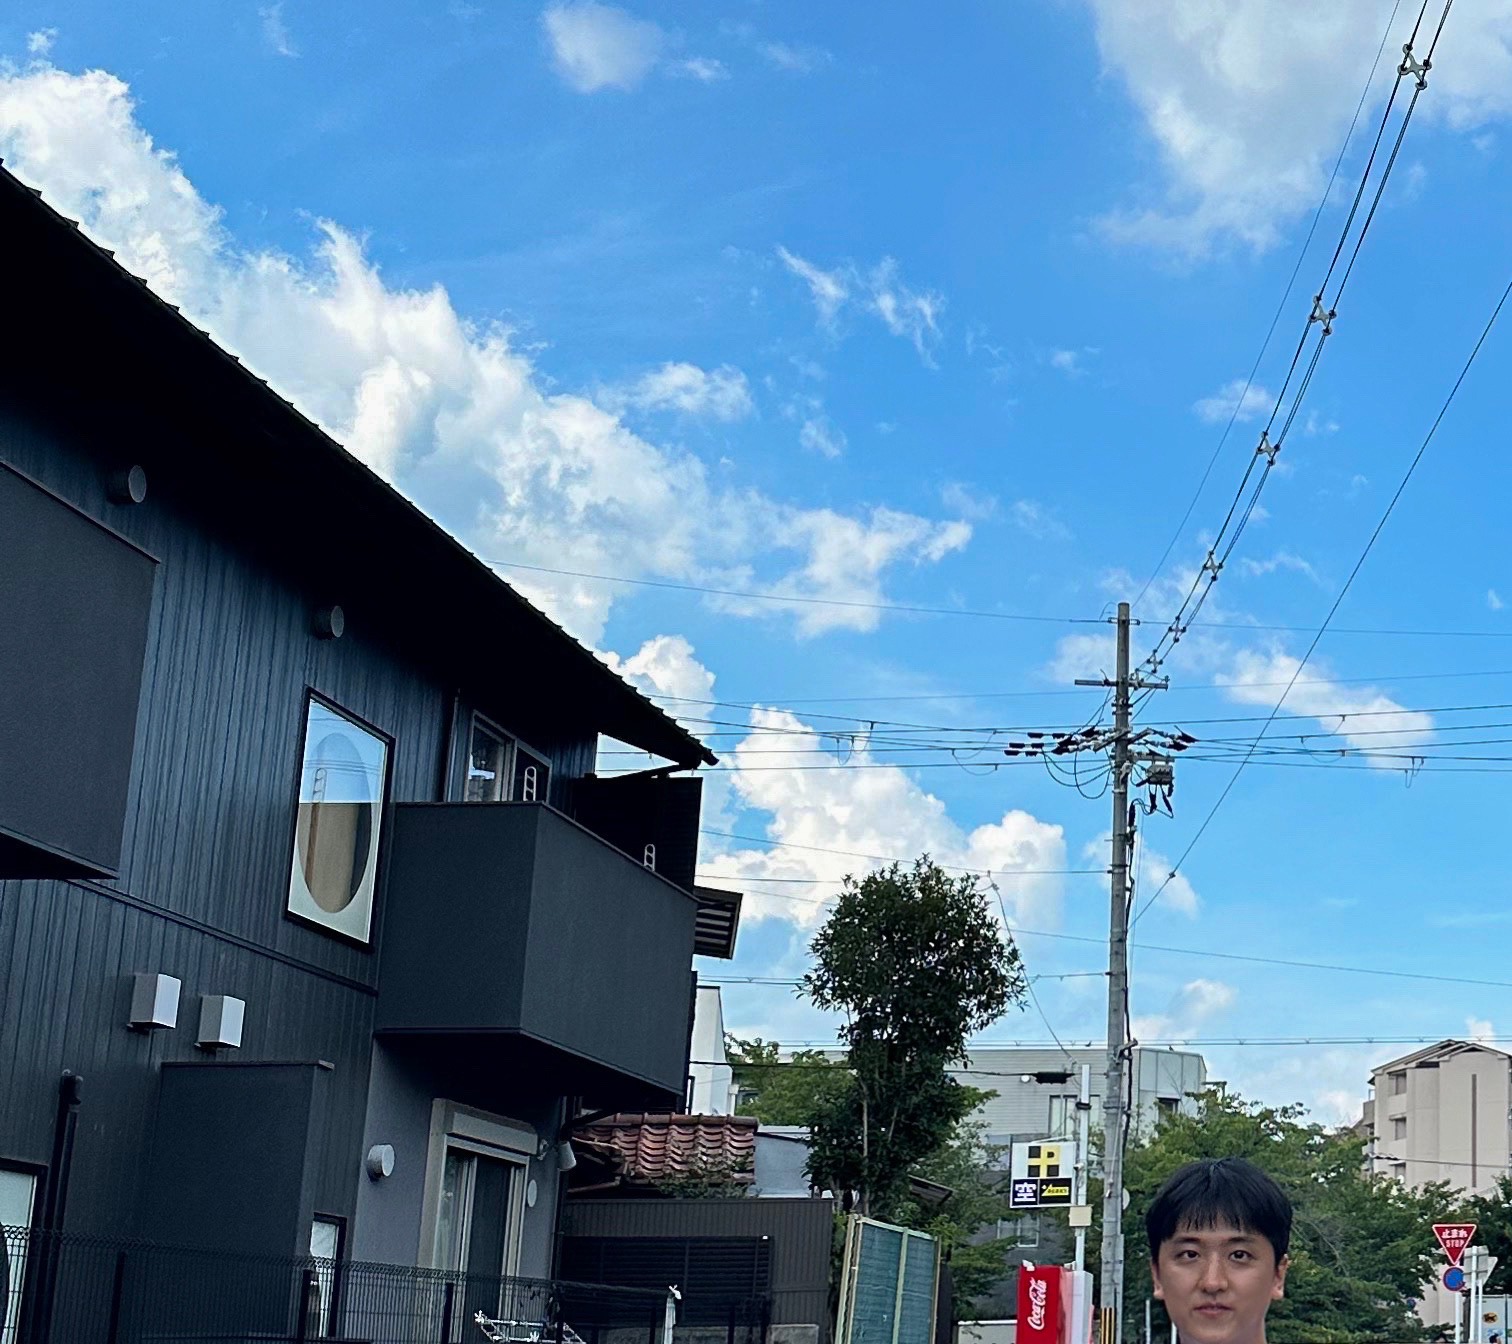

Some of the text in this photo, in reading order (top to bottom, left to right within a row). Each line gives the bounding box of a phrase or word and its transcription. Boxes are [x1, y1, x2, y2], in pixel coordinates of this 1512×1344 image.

[1014, 1182, 1037, 1202] 空
[1441, 1228, 1468, 1239] 止まれ
[1445, 1239, 1465, 1248] STOP
